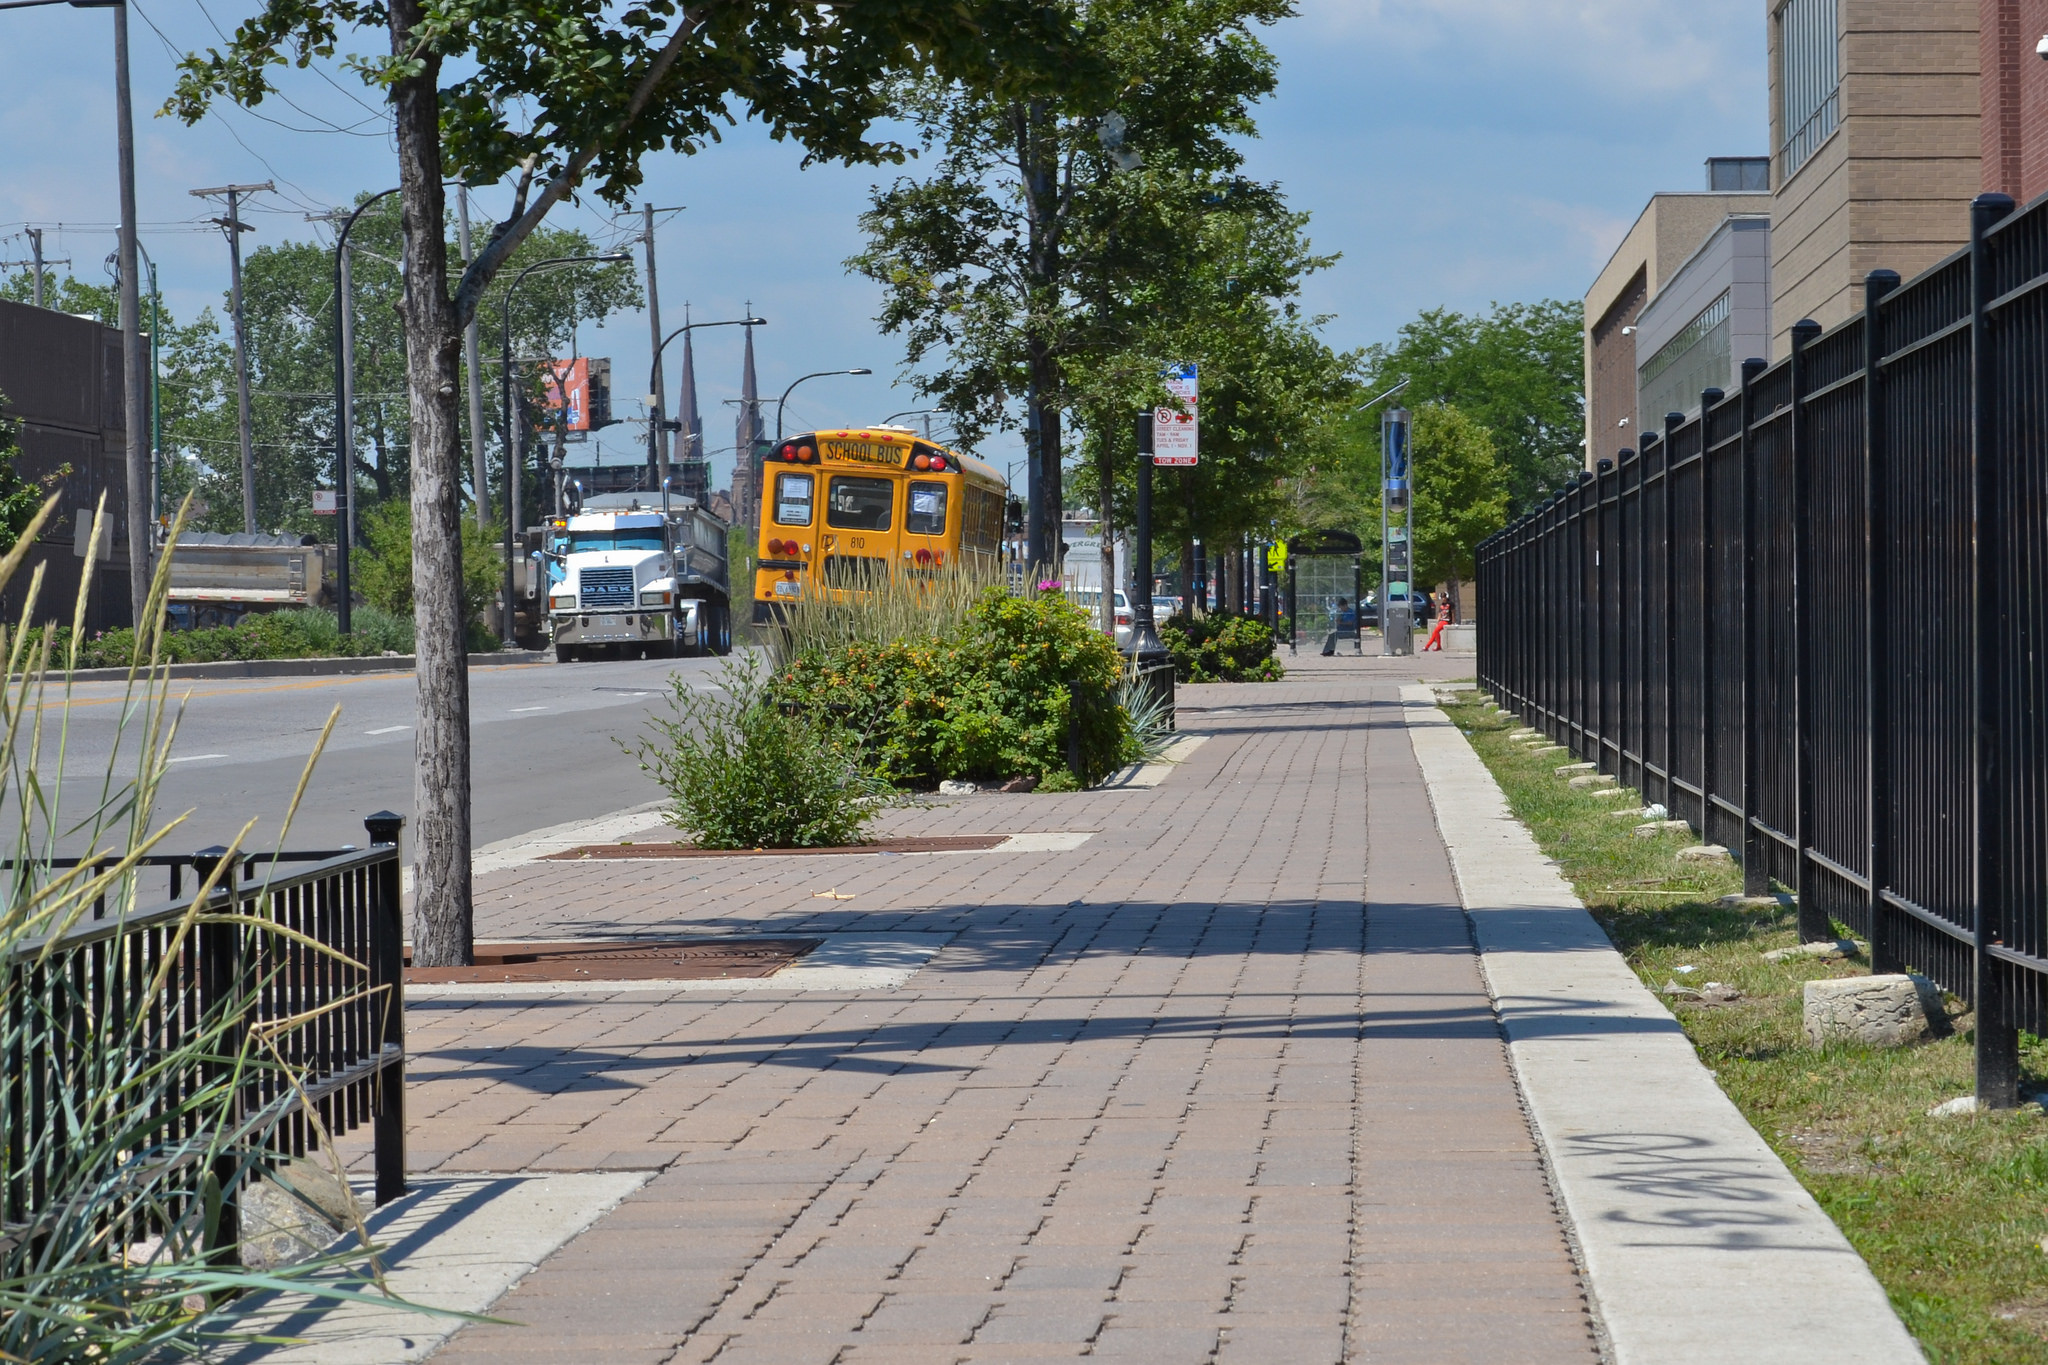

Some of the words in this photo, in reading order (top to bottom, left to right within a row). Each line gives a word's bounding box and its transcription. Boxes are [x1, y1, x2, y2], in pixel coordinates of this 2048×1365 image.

[826, 441, 873, 462] SCHOOL
[877, 445, 901, 464] BUS
[850, 536, 865, 549] 810
[582, 585, 632, 593] MACK
